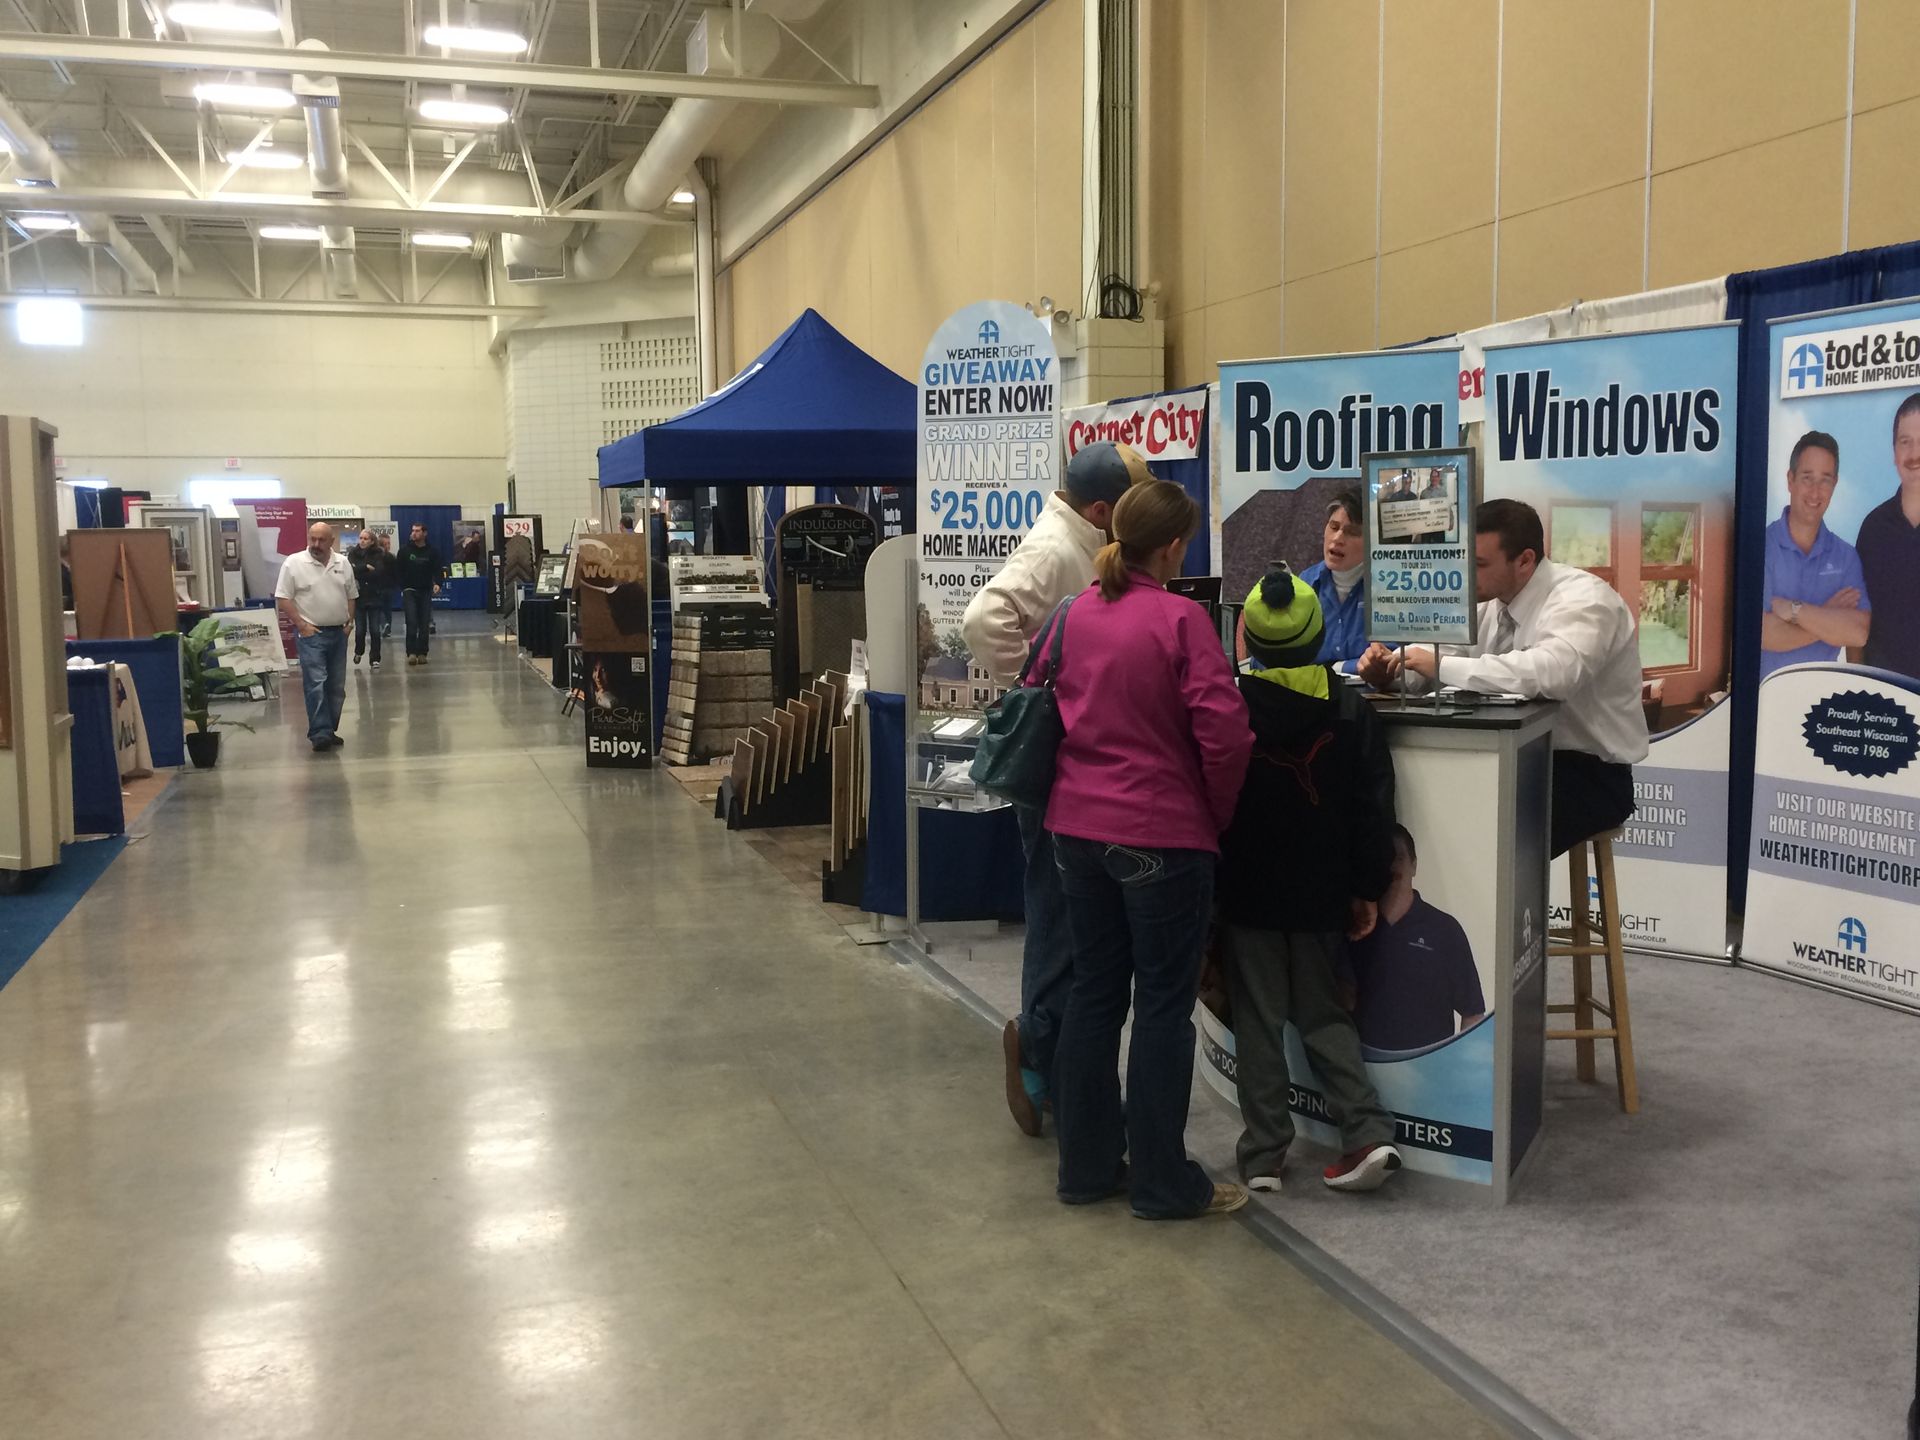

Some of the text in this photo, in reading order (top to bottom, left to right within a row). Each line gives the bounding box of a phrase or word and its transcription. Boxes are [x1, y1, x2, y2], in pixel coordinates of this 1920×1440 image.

[946, 344, 1036, 360] WEATHERTIGHT
[1825, 335, 1869, 371] tod
[1870, 334, 1892, 366] &
[925, 357, 1051, 386] GIVEAWAY
[1825, 370, 1859, 387] HOME
[925, 384, 1053, 416] ENTER NOW!
[1495, 369, 1721, 462] Windows
[924, 421, 1054, 441] GRAND PRIZE
[1145, 401, 1204, 455] City
[924, 441, 1051, 481] WINNER
[930, 488, 1043, 534] $25,000
[505, 522, 530, 535] $29
[789, 519, 868, 531] INDULGENCE
[923, 534, 963, 556] HOME
[1372, 548, 1466, 560] CONGRATULATIONS!
[975, 564, 990, 573] Plus
[920, 572, 966, 588] $1,000
[1378, 569, 1463, 593] $25,000
[942, 599, 955, 607] the
[949, 589, 961, 597] will
[962, 589, 972, 597] be
[1827, 707, 1898, 727] Proudly Serving
[1815, 723, 1909, 743] Southeast Wisconsin
[589, 736, 647, 758] Enjoy.
[1832, 741, 1890, 759] since 1986
[1776, 791, 1814, 814] VISIT
[1816, 797, 1847, 820] OUR
[1849, 802, 1915, 831] WEBSITE
[1768, 814, 1808, 838] HOME
[1811, 821, 1918, 857] IMPROVEMENT
[1792, 941, 1919, 987] WEATHERTIGHT
